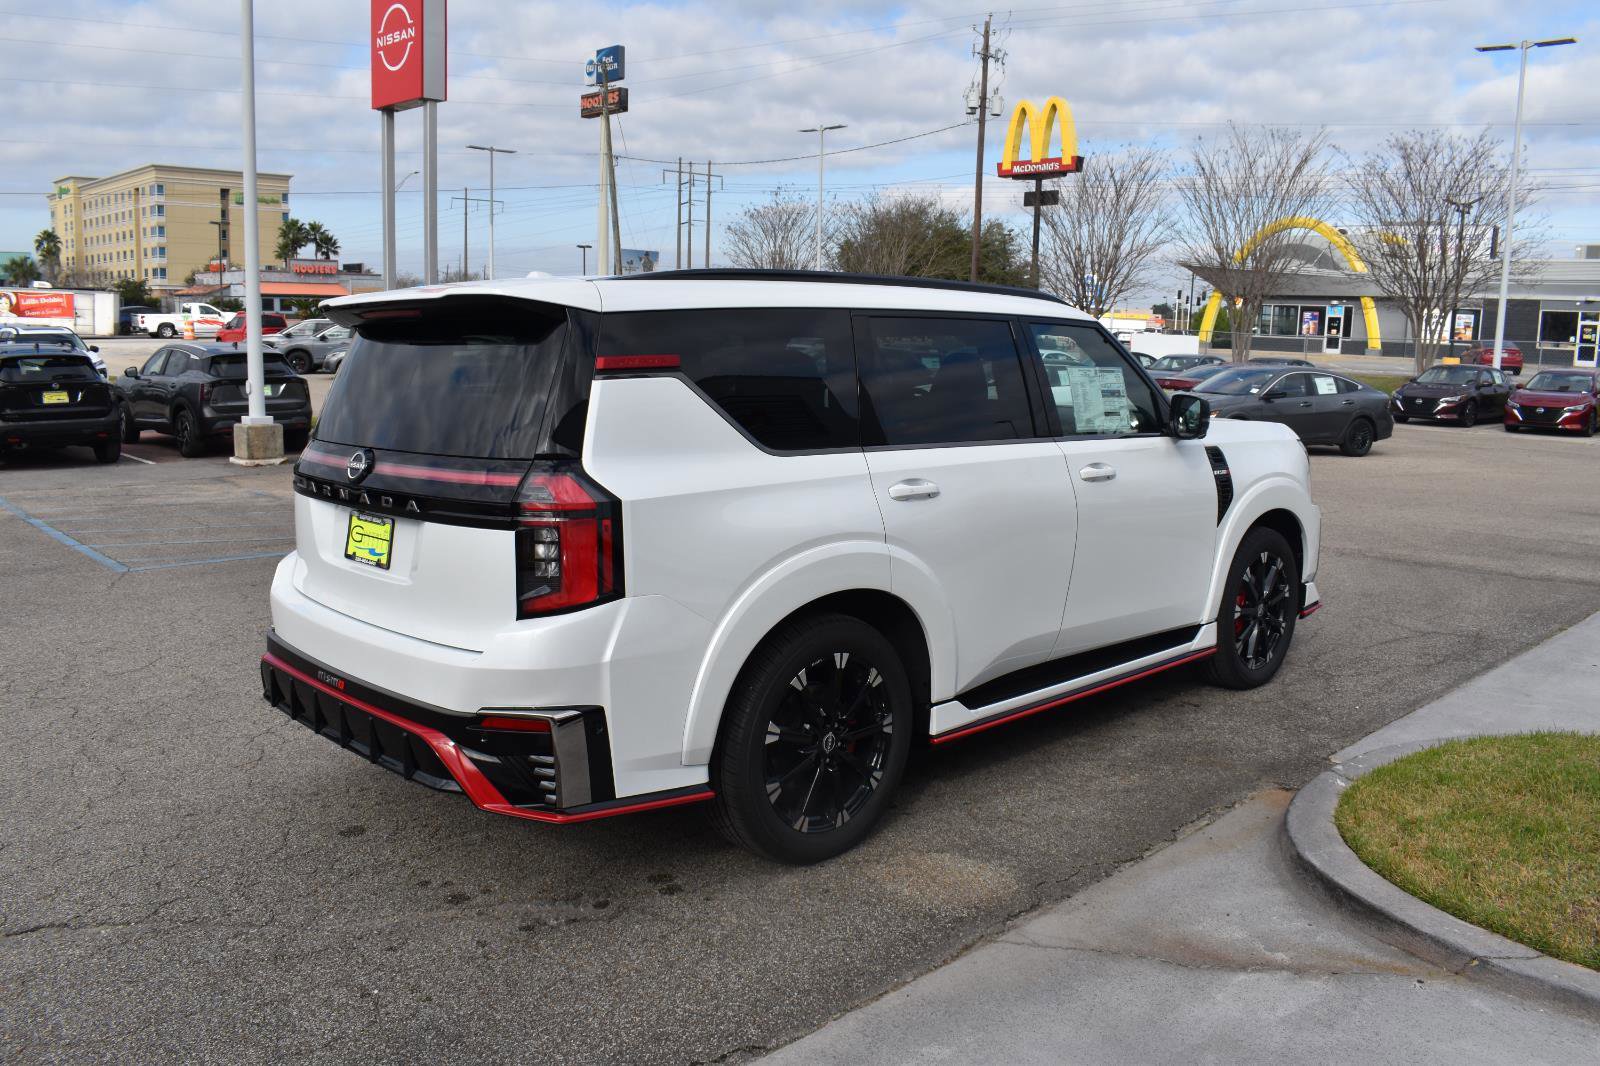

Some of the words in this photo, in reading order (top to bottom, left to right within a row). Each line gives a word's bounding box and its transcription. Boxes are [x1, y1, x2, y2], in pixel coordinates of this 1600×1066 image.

[376, 27, 415, 48] NISSAN
[1013, 162, 1060, 174] McDonald's
[293, 264, 337, 274] HOOTERS
